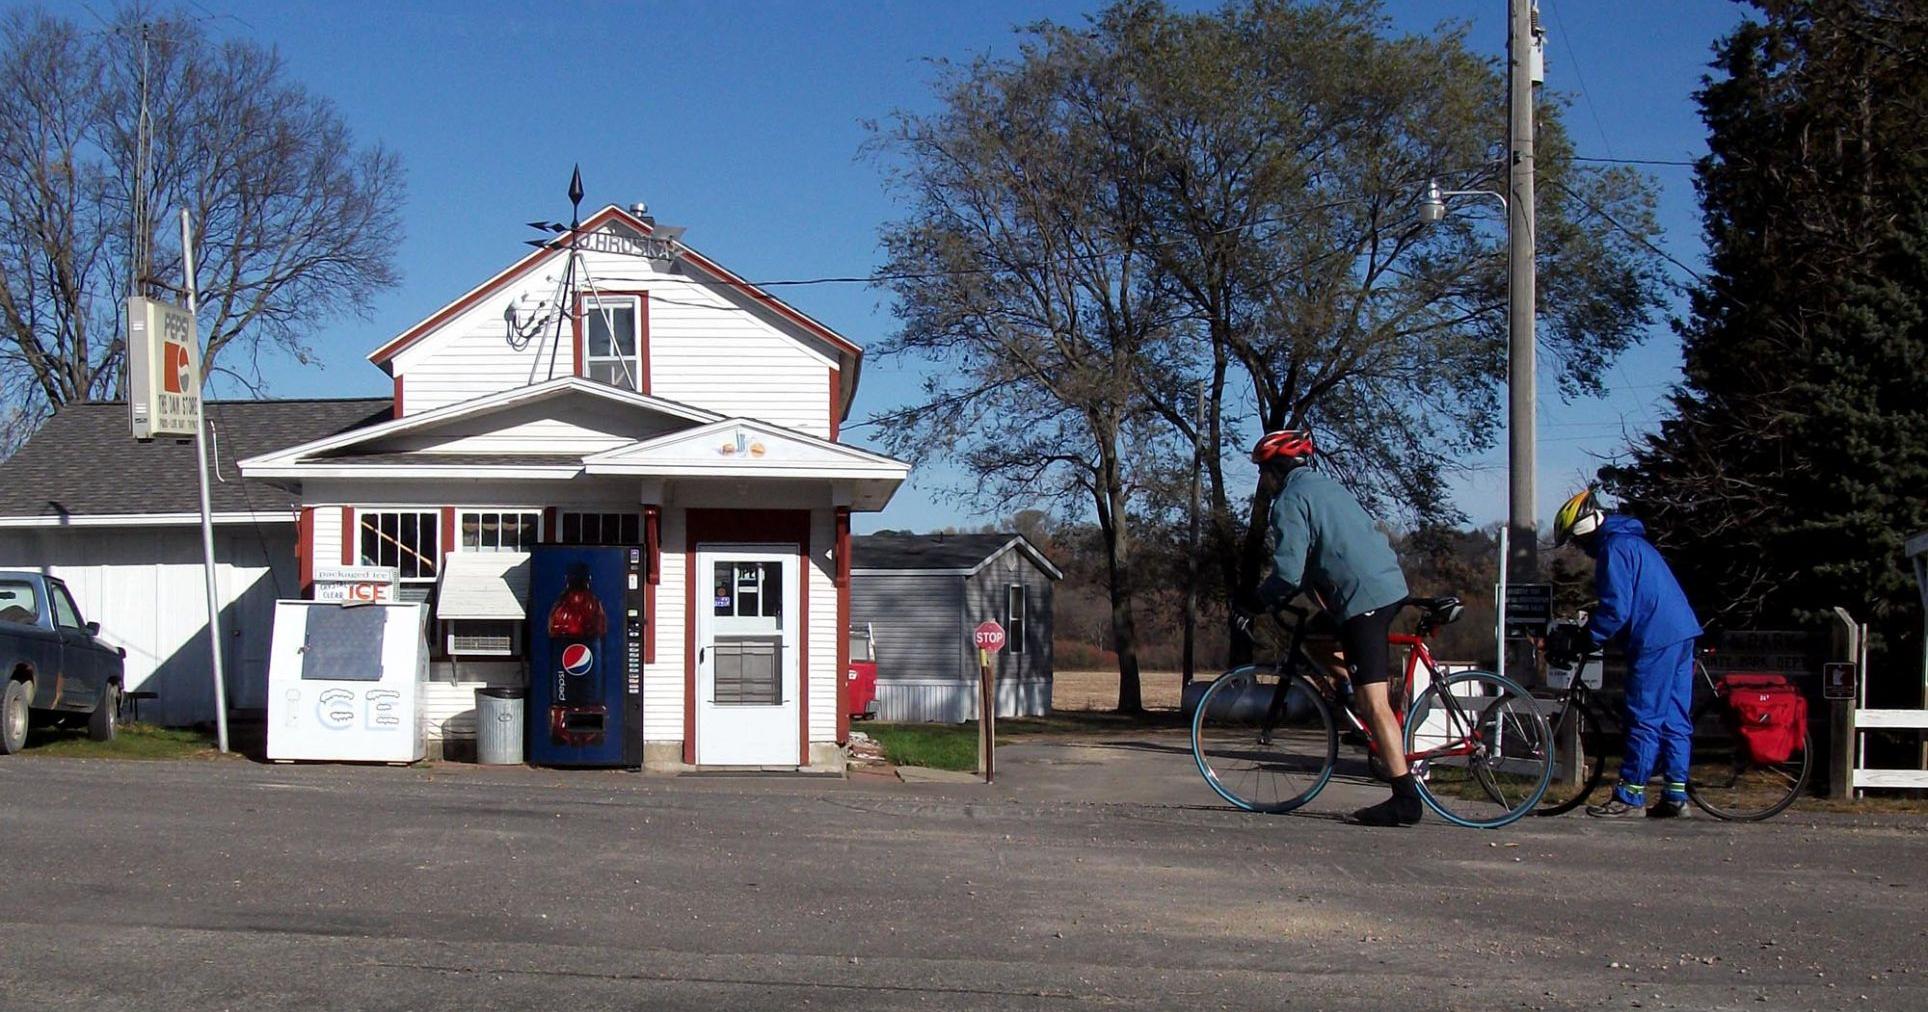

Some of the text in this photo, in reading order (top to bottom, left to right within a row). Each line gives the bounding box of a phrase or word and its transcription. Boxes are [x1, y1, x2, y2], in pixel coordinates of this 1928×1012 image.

[164, 312, 189, 342] PEPSI
[319, 570, 388, 580] packaged ice
[322, 591, 344, 600] CLEAR
[348, 582, 387, 600] ICE
[976, 632, 1002, 643] STOP
[557, 670, 565, 701] pepsi
[285, 687, 401, 731] ICE
